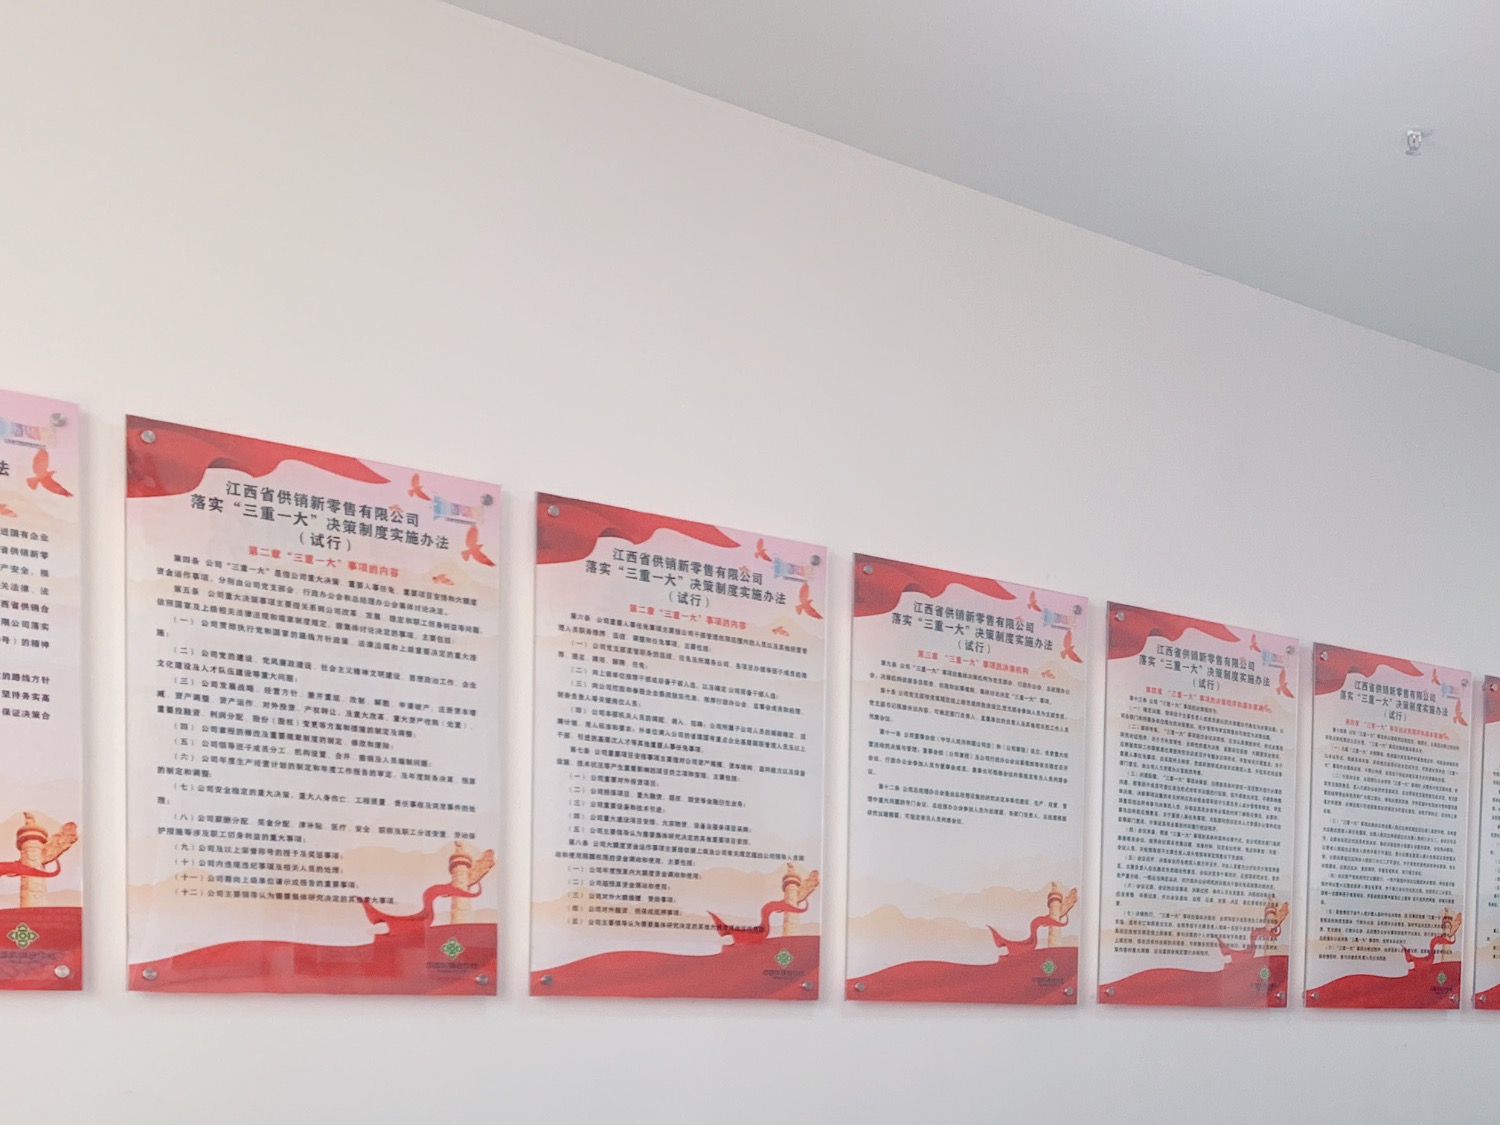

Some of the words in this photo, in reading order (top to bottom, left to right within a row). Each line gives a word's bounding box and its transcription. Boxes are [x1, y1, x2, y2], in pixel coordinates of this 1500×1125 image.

[225, 479, 419, 528] 江西省供销新零售有限公司
[299, 529, 352, 553] （试行）
[611, 546, 762, 586] 江西省供销新零售有限公司
[912, 600, 1034, 633] 江西省供销新零售有限公司
